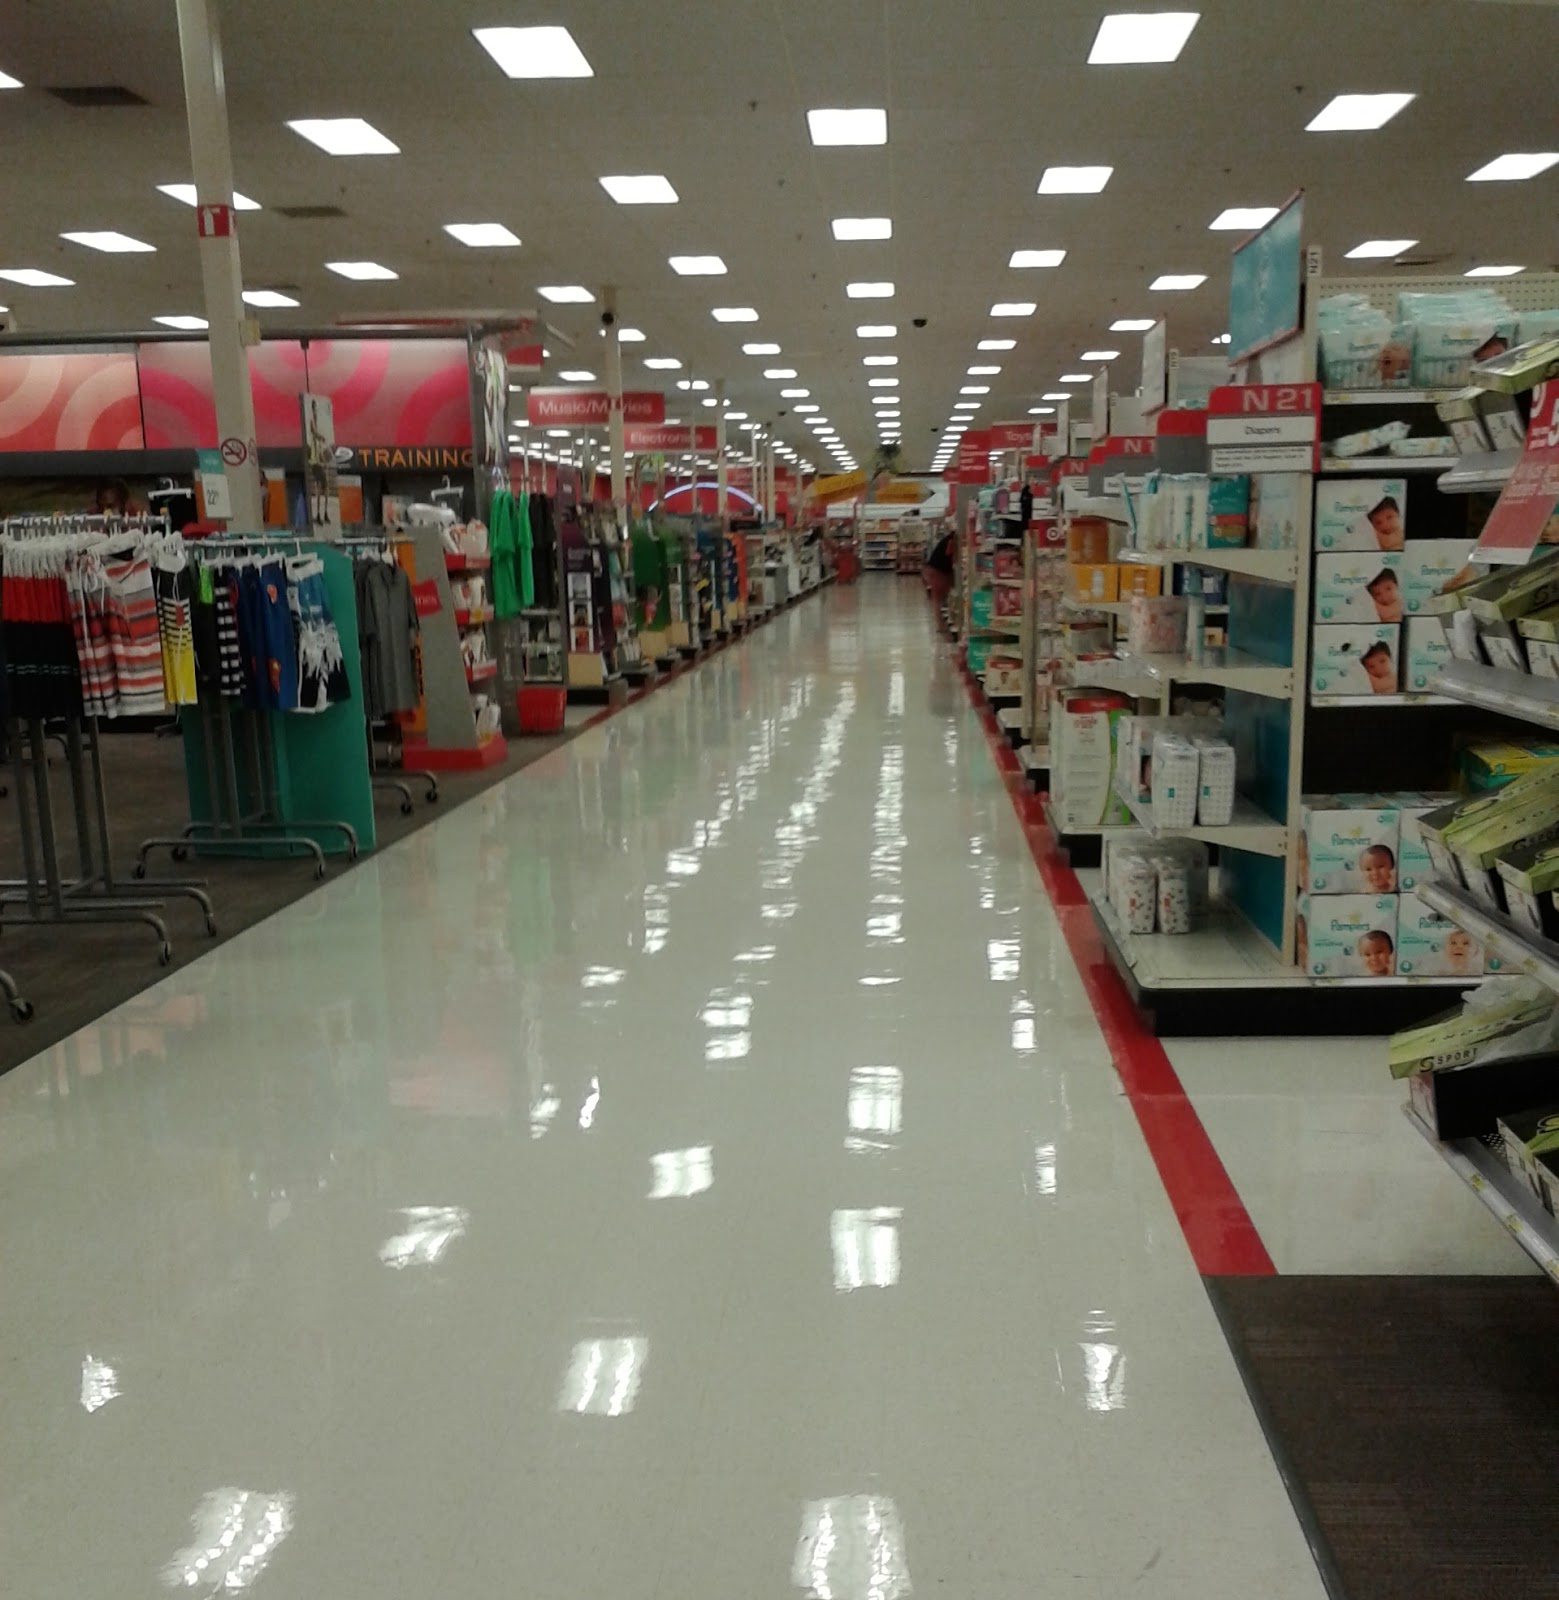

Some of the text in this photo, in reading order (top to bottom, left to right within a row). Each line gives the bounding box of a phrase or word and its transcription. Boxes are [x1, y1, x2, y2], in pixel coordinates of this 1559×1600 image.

[538, 400, 652, 416] Music/Mvies
[1331, 833, 1371, 846] Pampers
[1331, 919, 1370, 932] Pampers
[1437, 1047, 1478, 1064] SPORT
